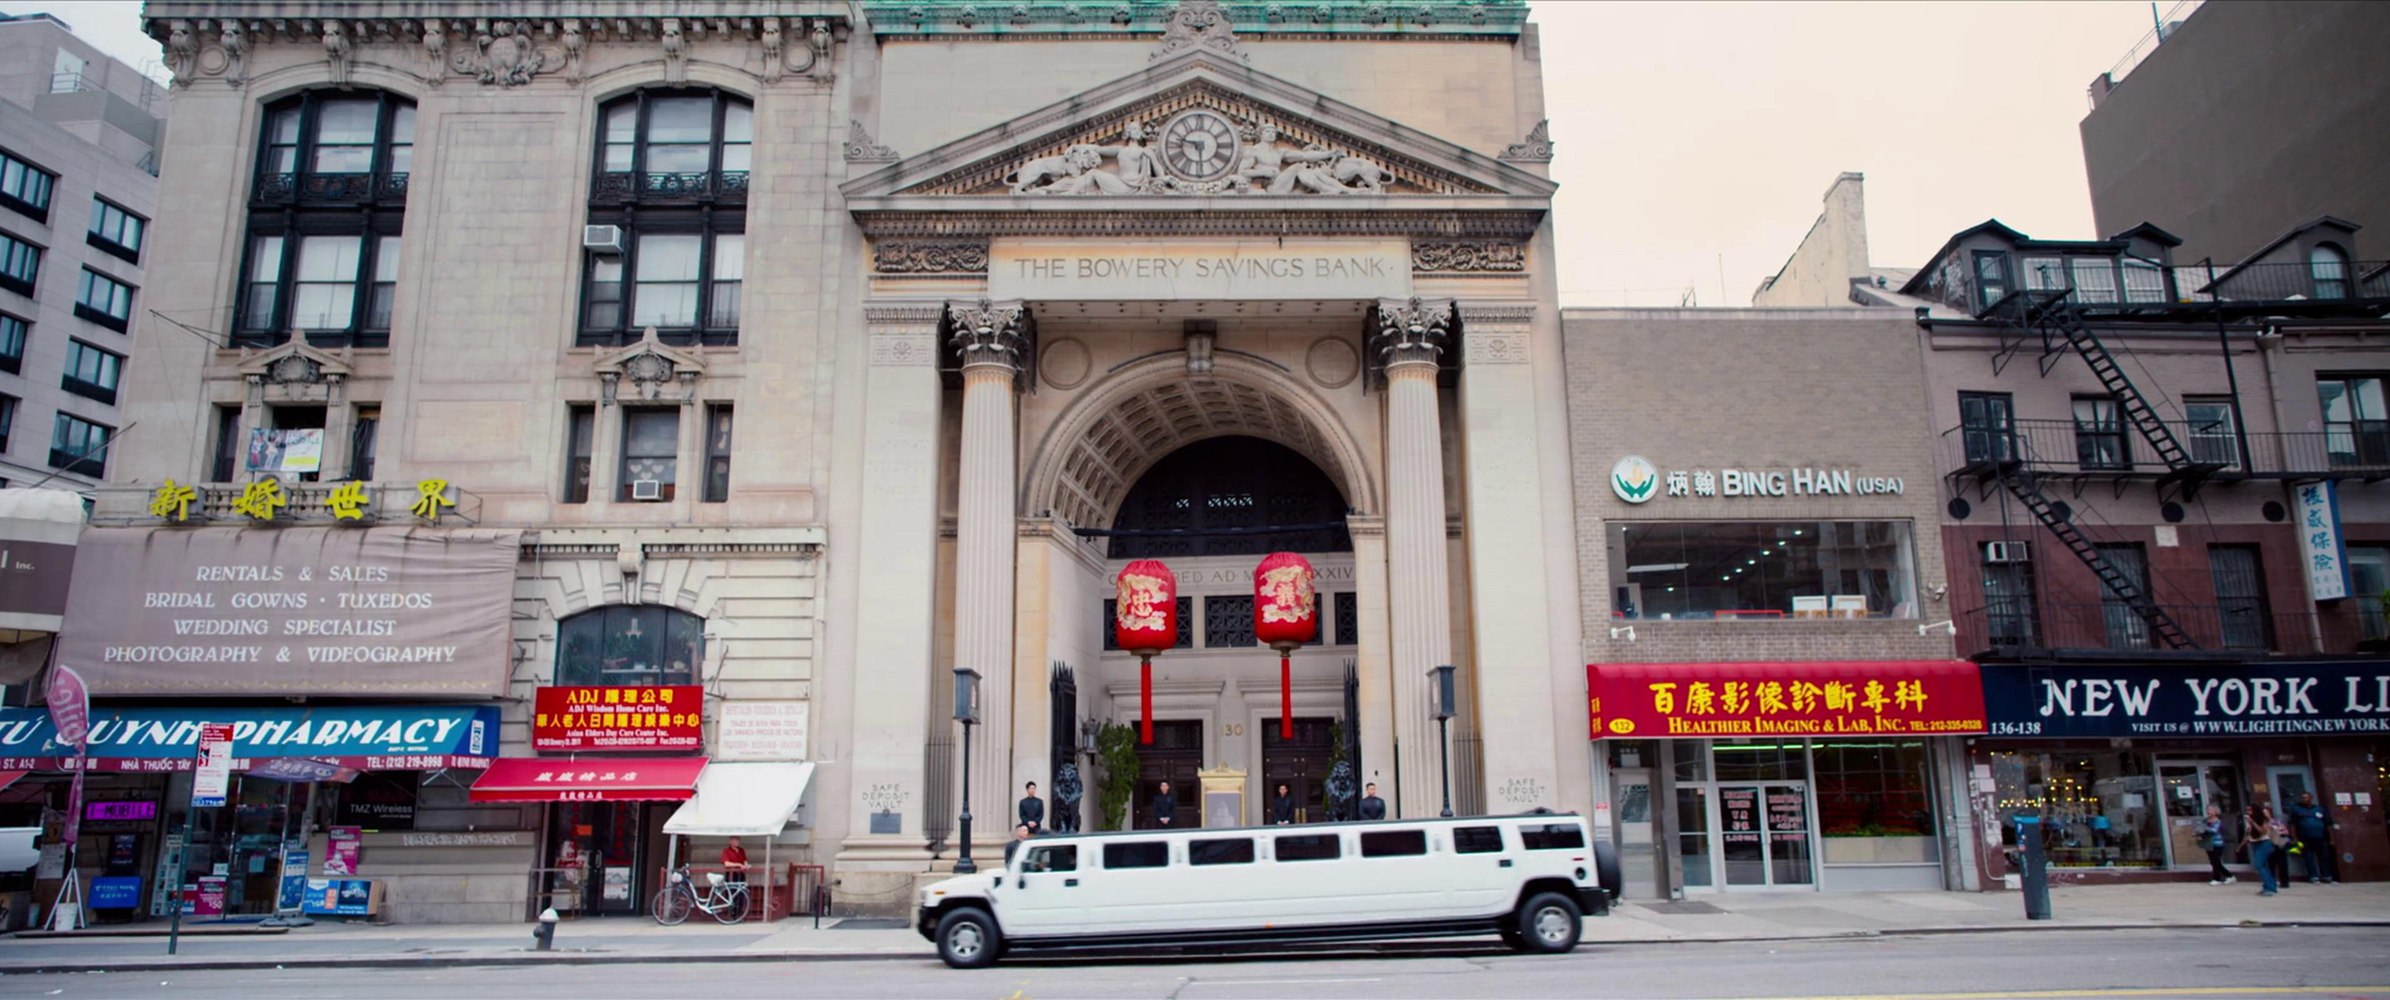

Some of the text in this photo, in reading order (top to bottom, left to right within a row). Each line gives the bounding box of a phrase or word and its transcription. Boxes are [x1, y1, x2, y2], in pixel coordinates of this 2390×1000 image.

[1015, 257, 1385, 278] THE BOWERY SAVINGS BANK
[1721, 469, 1787, 496] BING
[1793, 468, 1850, 495] HAN
[1856, 477, 1904, 495] (USA)
[149, 478, 456, 521] 新婚世界
[15, 560, 35, 570] Inc.
[196, 566, 388, 581] RENTALS & SALES
[144, 592, 432, 608] BRIDAL GOWNS TUXEDOS
[174, 619, 396, 636] WEDDING SPECIALIST
[104, 646, 456, 663] PHOTOGRAPHY & VIDEOGRAPHY
[566, 689, 599, 704] ADJ
[2039, 679, 2160, 716] NEW
[2184, 677, 2319, 716] YORK
[568, 705, 585, 713] ADJ
[1668, 717, 1752, 734] HEALTHIER
[1754, 716, 1820, 733] IMAGING
[1823, 719, 1835, 732] &
[1837, 715, 1873, 734] LAB,
[1875, 715, 1906, 731] INC.
[1909, 720, 1930, 731] TEL:
[1991, 721, 2042, 735] 136-138
[2132, 722, 2160, 732] VISIT
[2164, 722, 2177, 732] US
[2179, 722, 2190, 733] @
[233, 718, 461, 746] PHARMACY
[121, 757, 139, 770] NHÀ
[367, 757, 385, 768] TEL:
[386, 757, 405, 768] (212)
[873, 783, 899, 791] SAFE
[1508, 778, 1534, 786] SAFE
[862, 792, 909, 800] DEPOSIT
[1499, 786, 1545, 795] DEPOSIT
[350, 803, 412, 813] TMZ Wireless
[868, 800, 902, 808] VAULT
